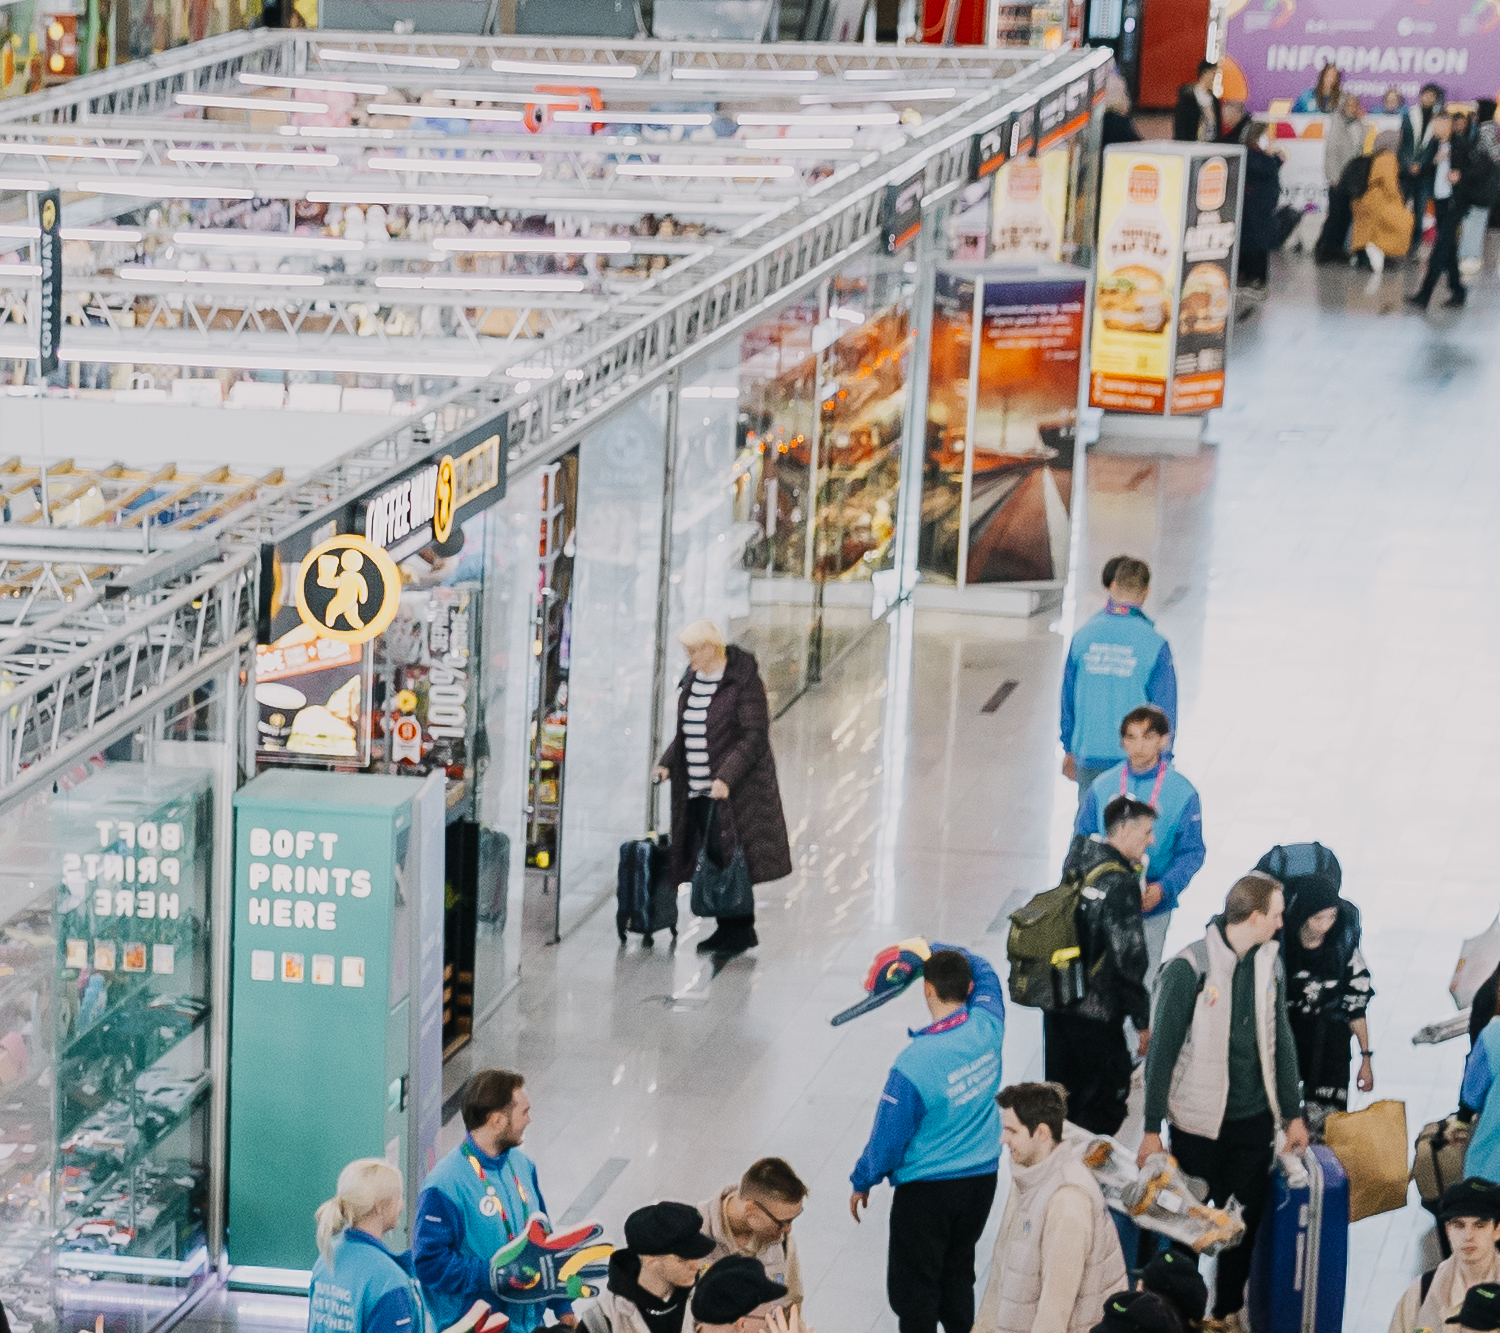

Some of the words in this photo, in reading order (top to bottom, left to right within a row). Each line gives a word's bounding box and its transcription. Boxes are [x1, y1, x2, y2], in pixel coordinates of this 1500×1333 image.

[1266, 44, 1469, 75] INFORMATION
[249, 827, 338, 861] BOFT
[248, 862, 372, 898] PRINTS
[248, 896, 337, 931] HERE
